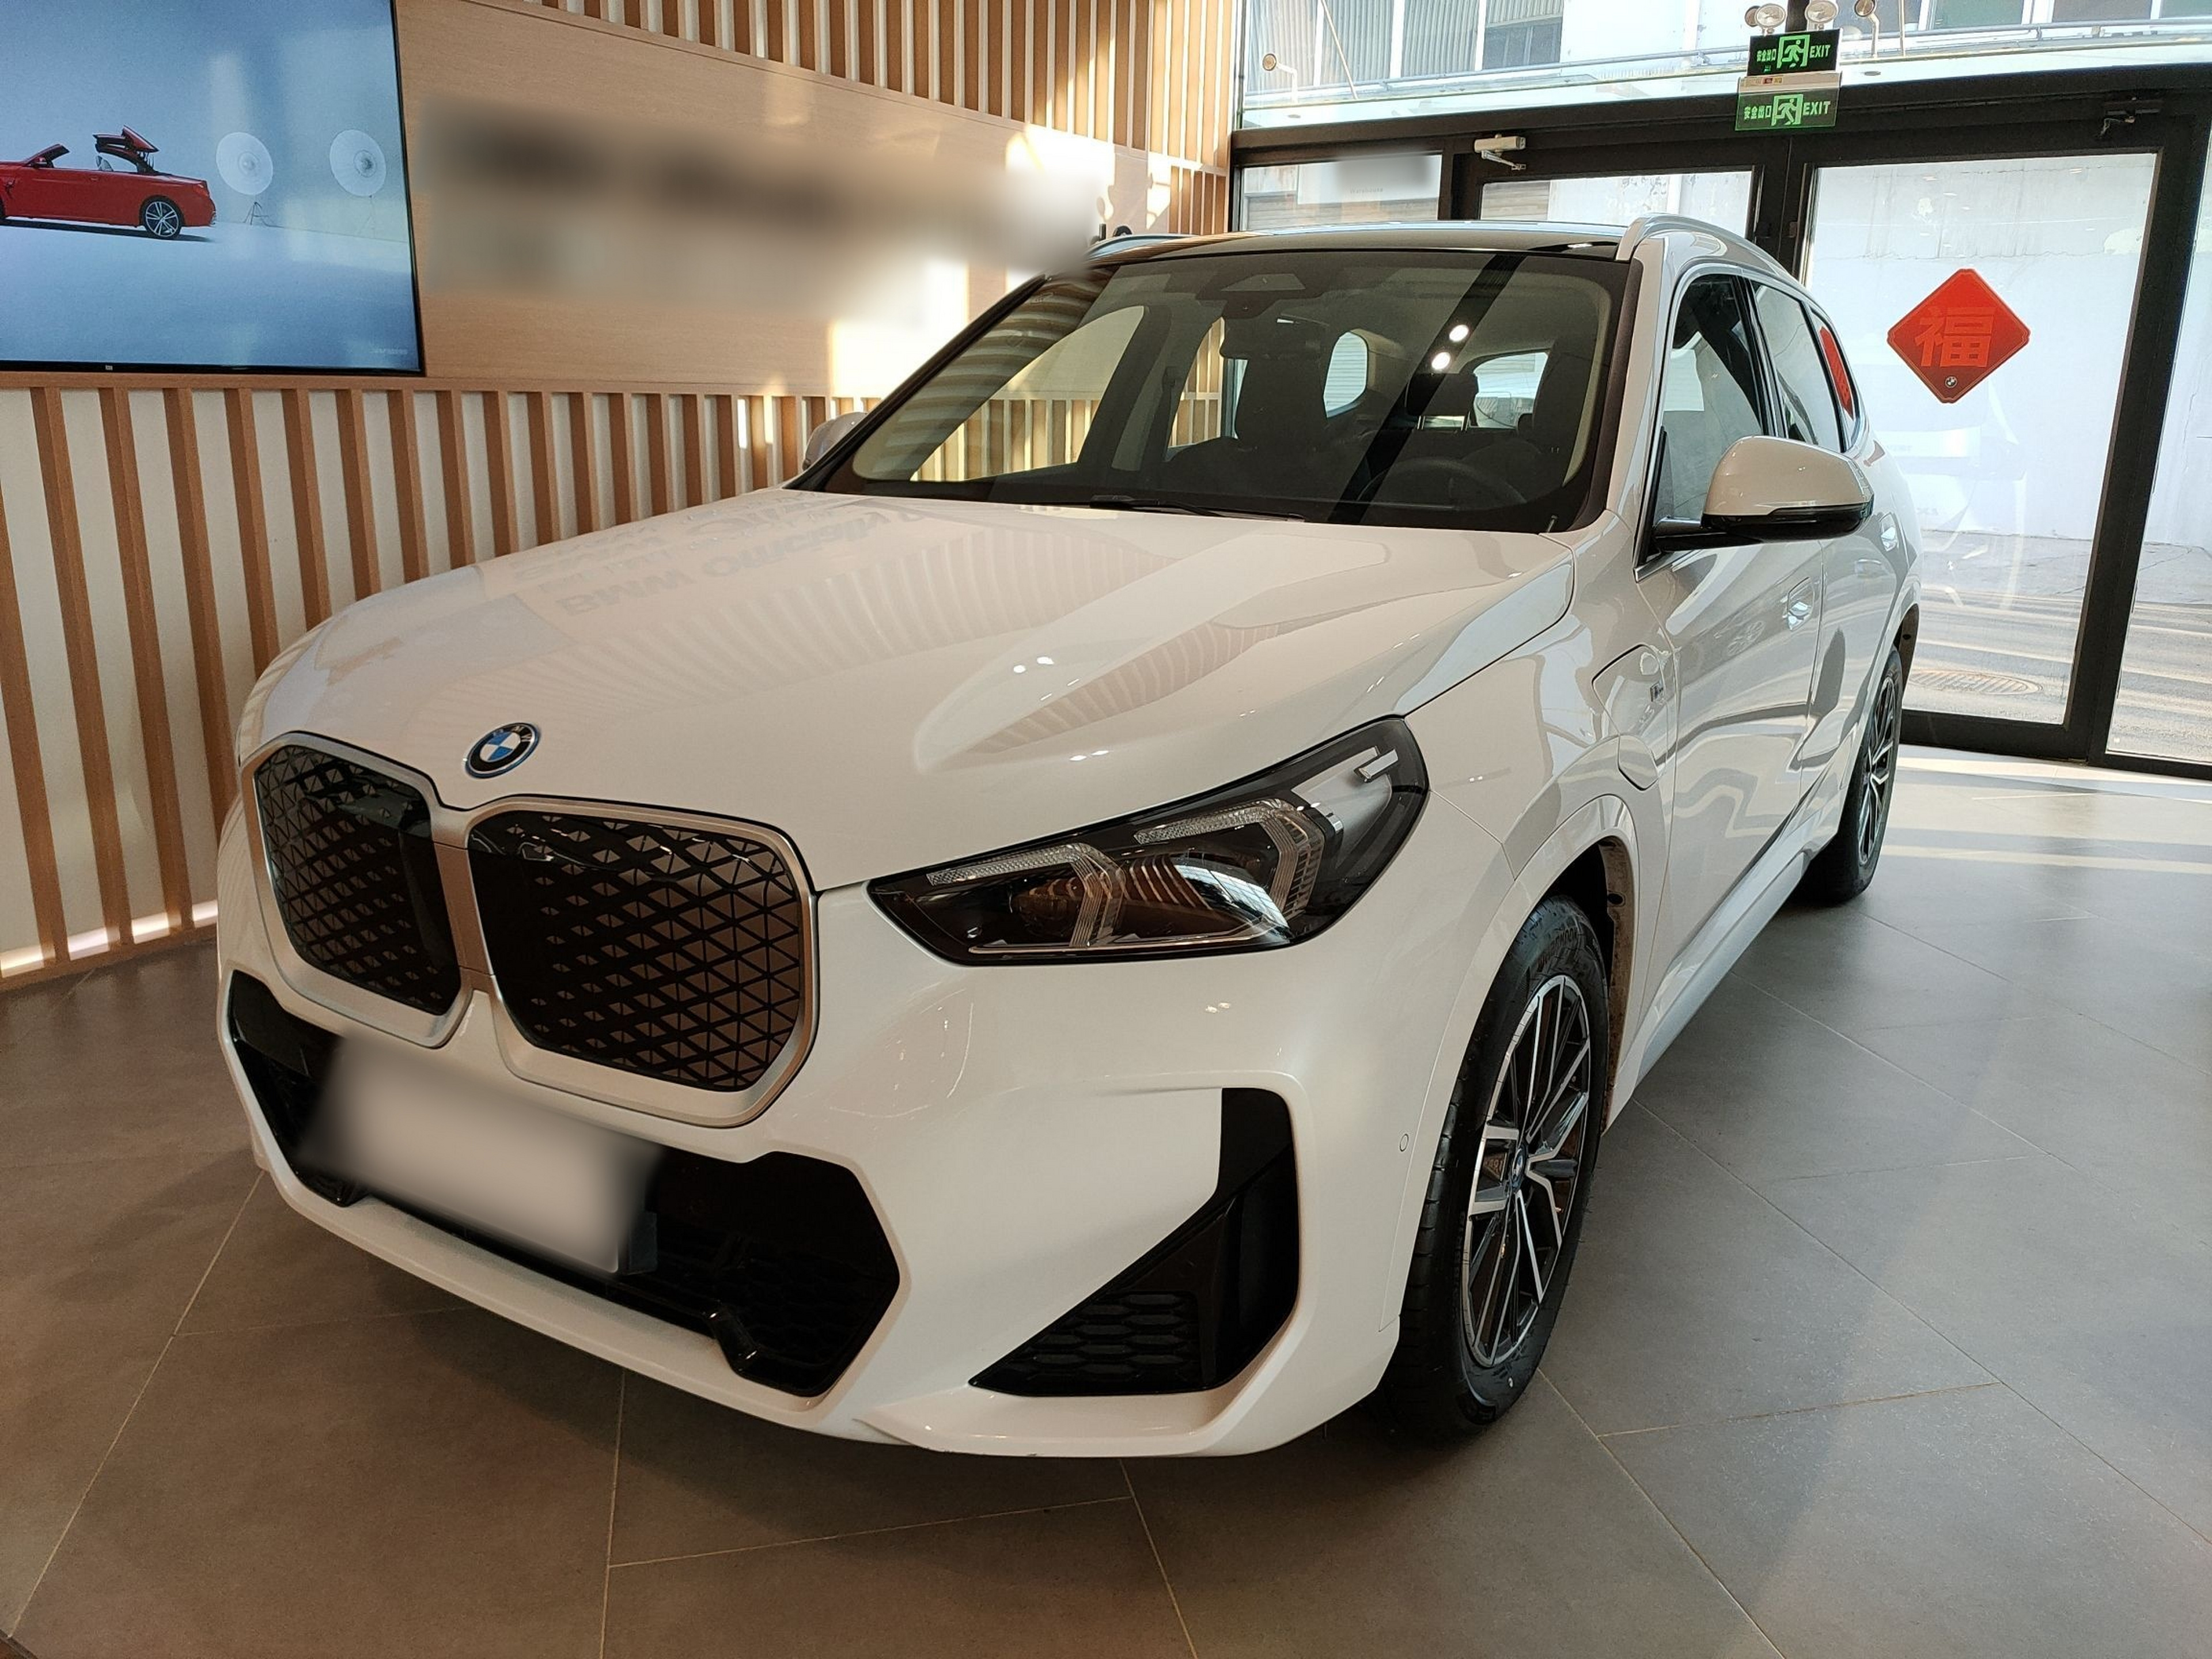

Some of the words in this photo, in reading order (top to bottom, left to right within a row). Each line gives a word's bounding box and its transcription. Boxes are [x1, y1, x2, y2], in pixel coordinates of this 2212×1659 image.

[1756, 48, 1777, 62] 安全出口
[1810, 45, 1831, 58] EXIT
[1744, 105, 1772, 120] 安全出口
[1803, 101, 1831, 115] EXIT
[1914, 306, 1997, 368] 福
